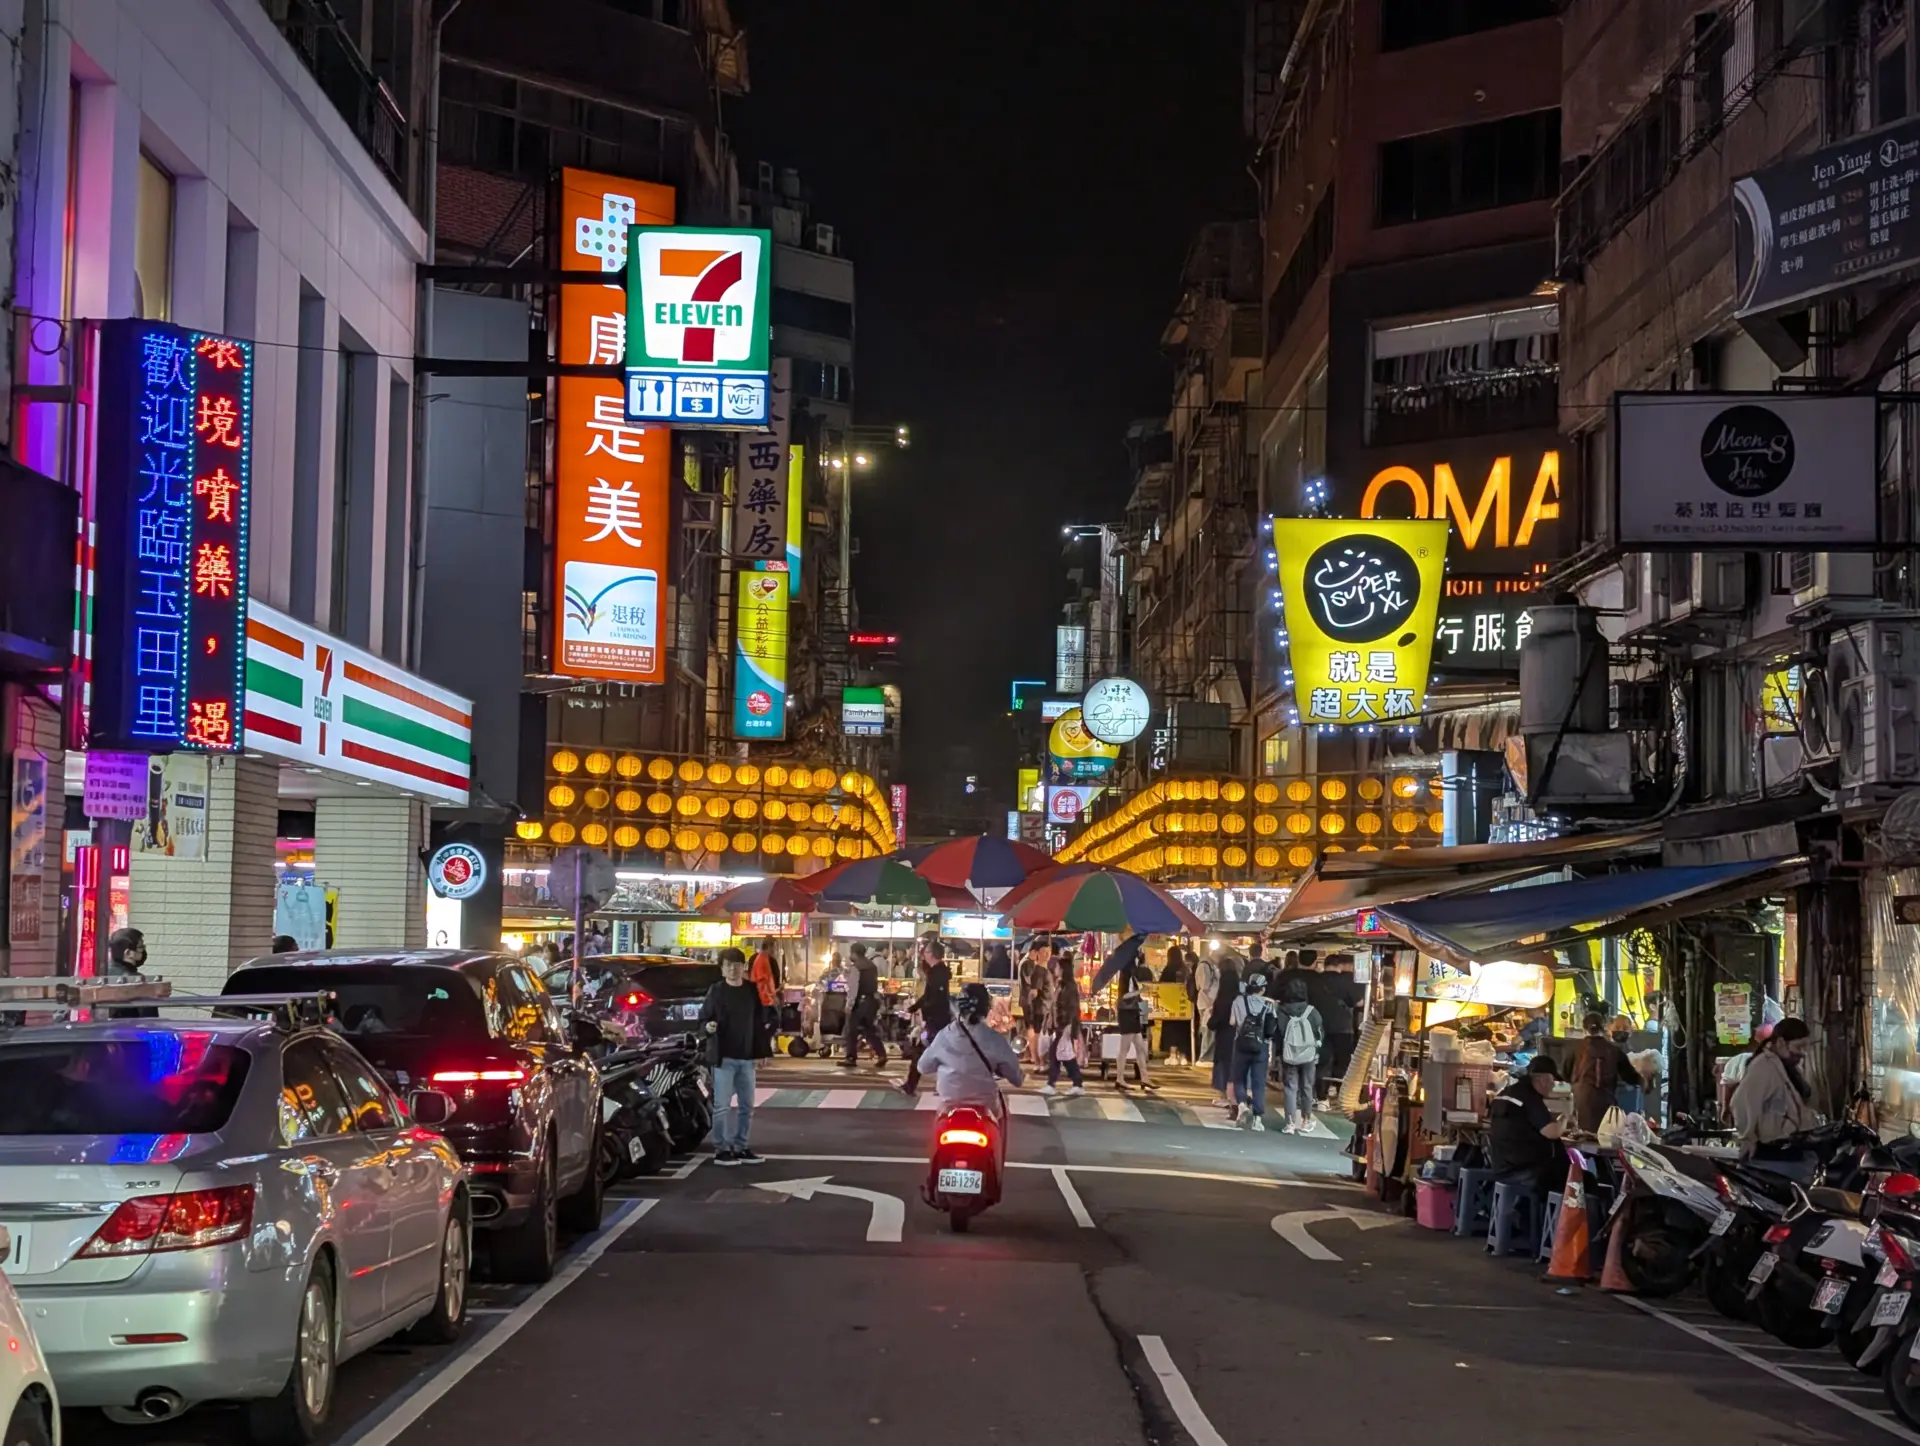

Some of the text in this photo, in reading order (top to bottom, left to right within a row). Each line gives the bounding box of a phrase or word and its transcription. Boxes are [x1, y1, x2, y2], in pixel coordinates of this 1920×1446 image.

[1811, 150, 1872, 181] Jen Yang
[660, 249, 742, 362] 7
[682, 382, 714, 393] ATM
[728, 393, 760, 406] Wi-Fi
[132, 333, 190, 737] 歡迎光臨玉田里
[1332, 570, 1401, 606] SUPER
[1379, 592, 1409, 614] XL
[610, 604, 646, 627] 退稅
[616, 626, 640, 634] TAIWAN
[755, 603, 769, 658] 公益彩券
[1329, 650, 1397, 684] 就是
[1309, 687, 1416, 719] 超大杯
